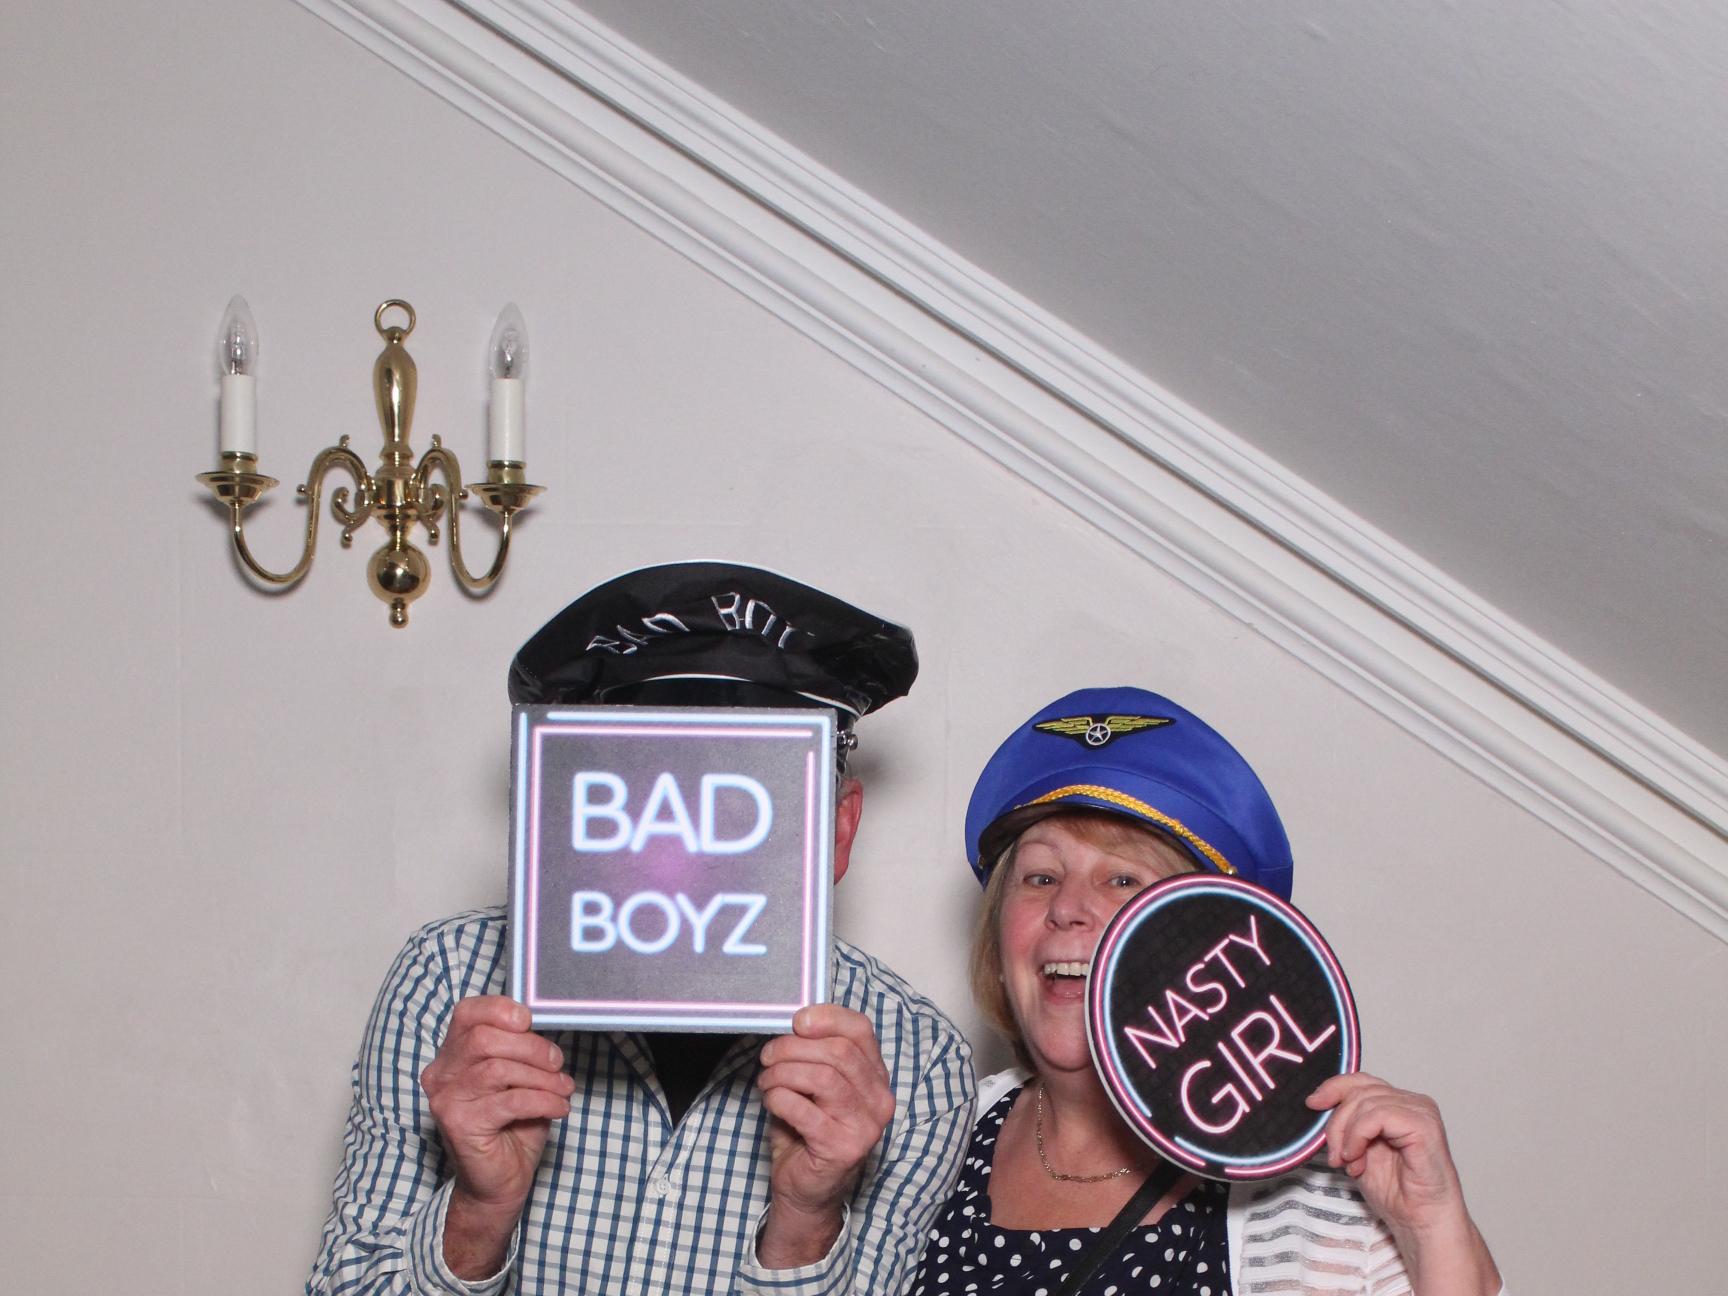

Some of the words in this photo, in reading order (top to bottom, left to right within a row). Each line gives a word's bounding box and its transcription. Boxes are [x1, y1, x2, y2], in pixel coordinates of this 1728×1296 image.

[571, 771, 774, 853] BAD
[570, 890, 768, 955] BOYZ
[1124, 914, 1271, 1069] NASTY
[1180, 994, 1336, 1134] GIRL
